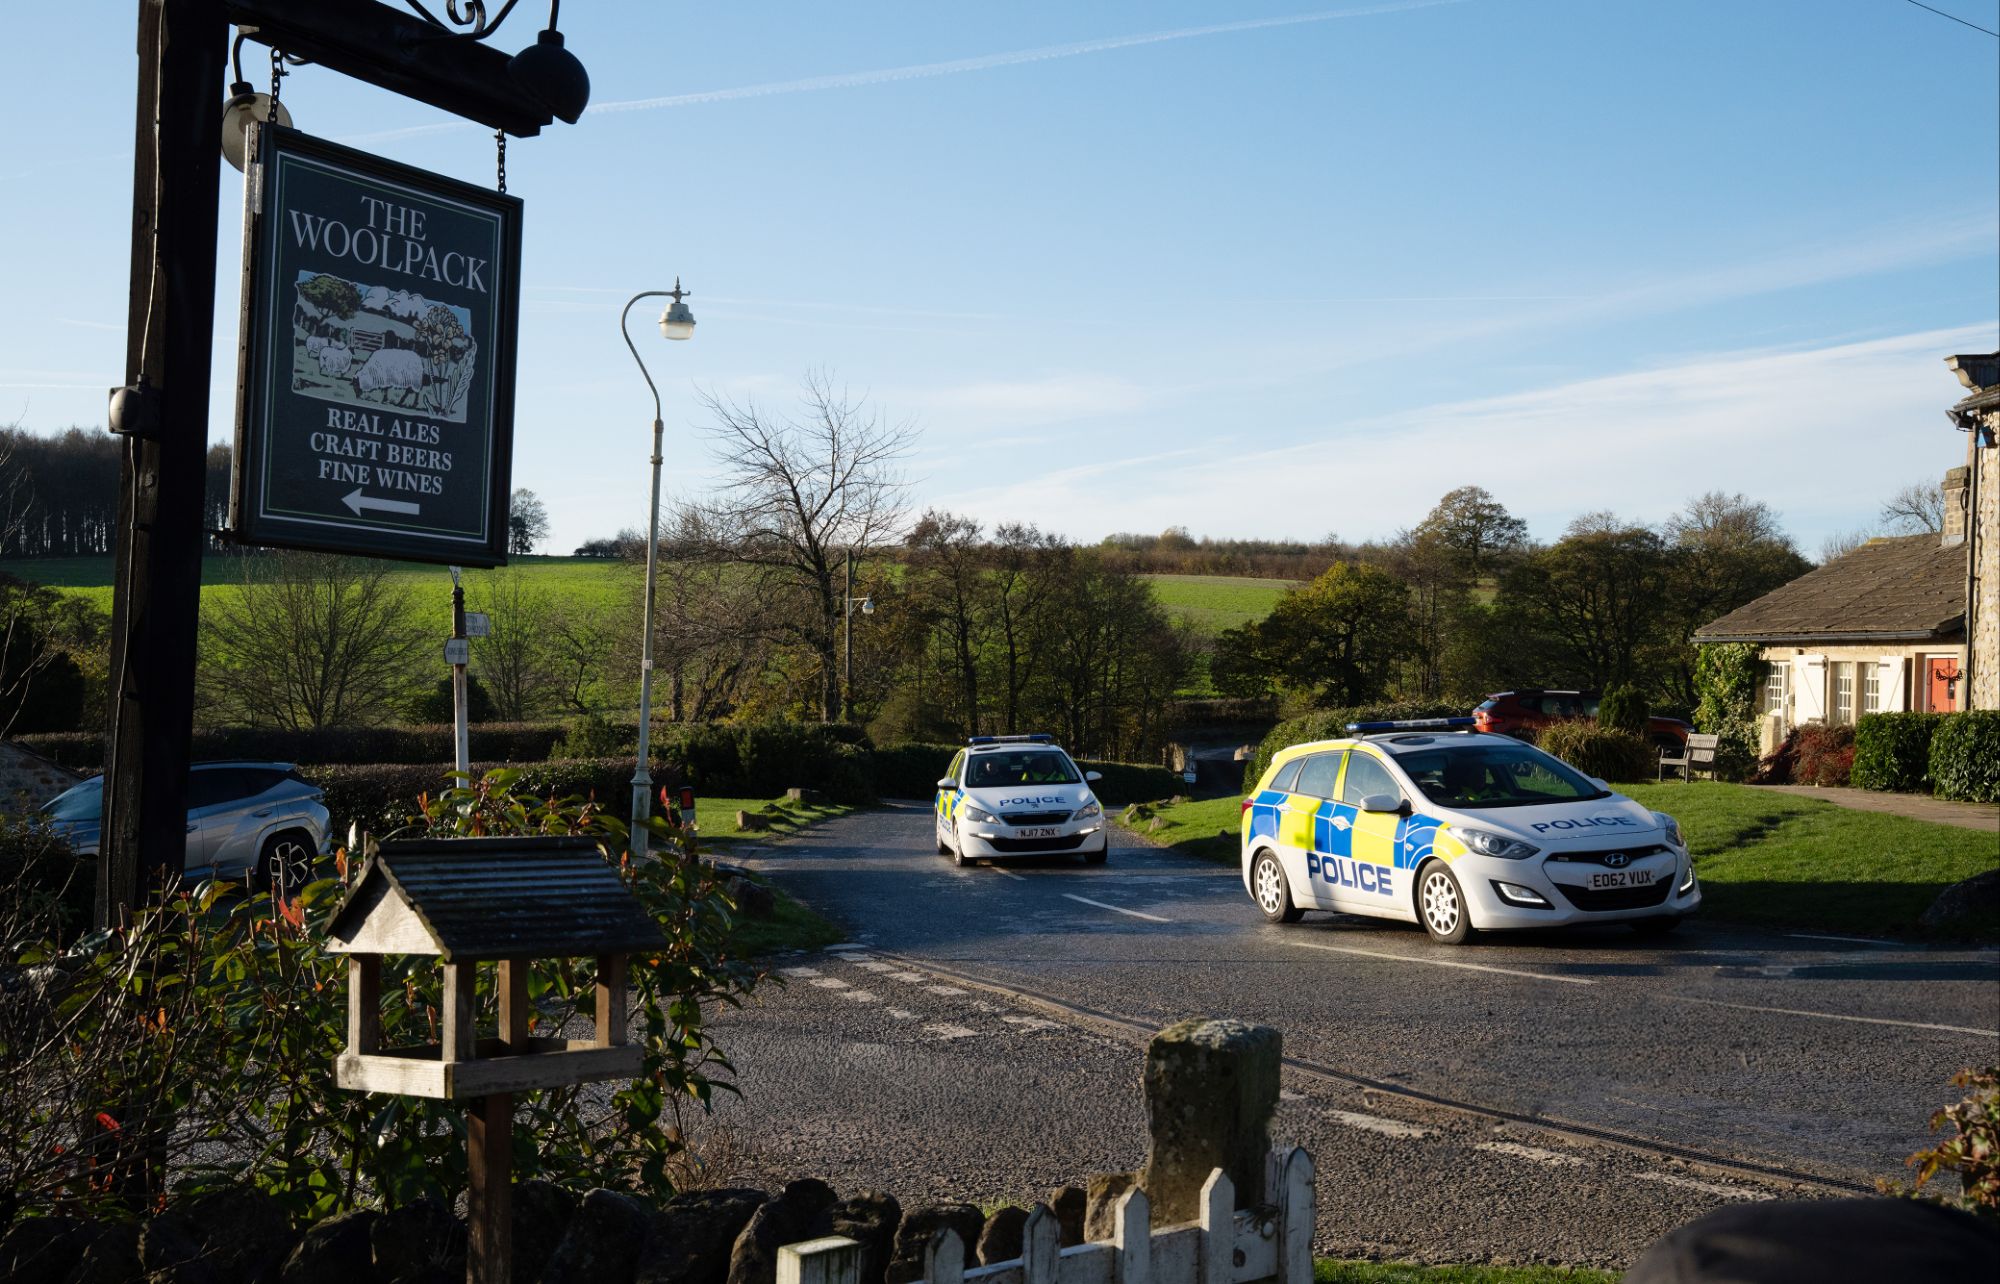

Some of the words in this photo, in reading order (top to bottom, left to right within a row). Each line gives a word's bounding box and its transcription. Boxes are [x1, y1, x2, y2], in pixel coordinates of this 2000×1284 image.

[360, 195, 426, 242] THE
[288, 209, 487, 293] WOOLPACK
[327, 407, 384, 435] REAL
[389, 419, 440, 445] ALES
[310, 432, 381, 460] CRAFT
[386, 443, 452, 471] BEERS
[318, 459, 370, 485] FINE
[376, 467, 443, 495] WINES
[999, 796, 1067, 807] POLICE
[1040, 827, 1056, 837] ZNX
[1530, 816, 1637, 833] POLICE
[1306, 852, 1393, 896] POLICE
[1628, 870, 1652, 885] VUX
